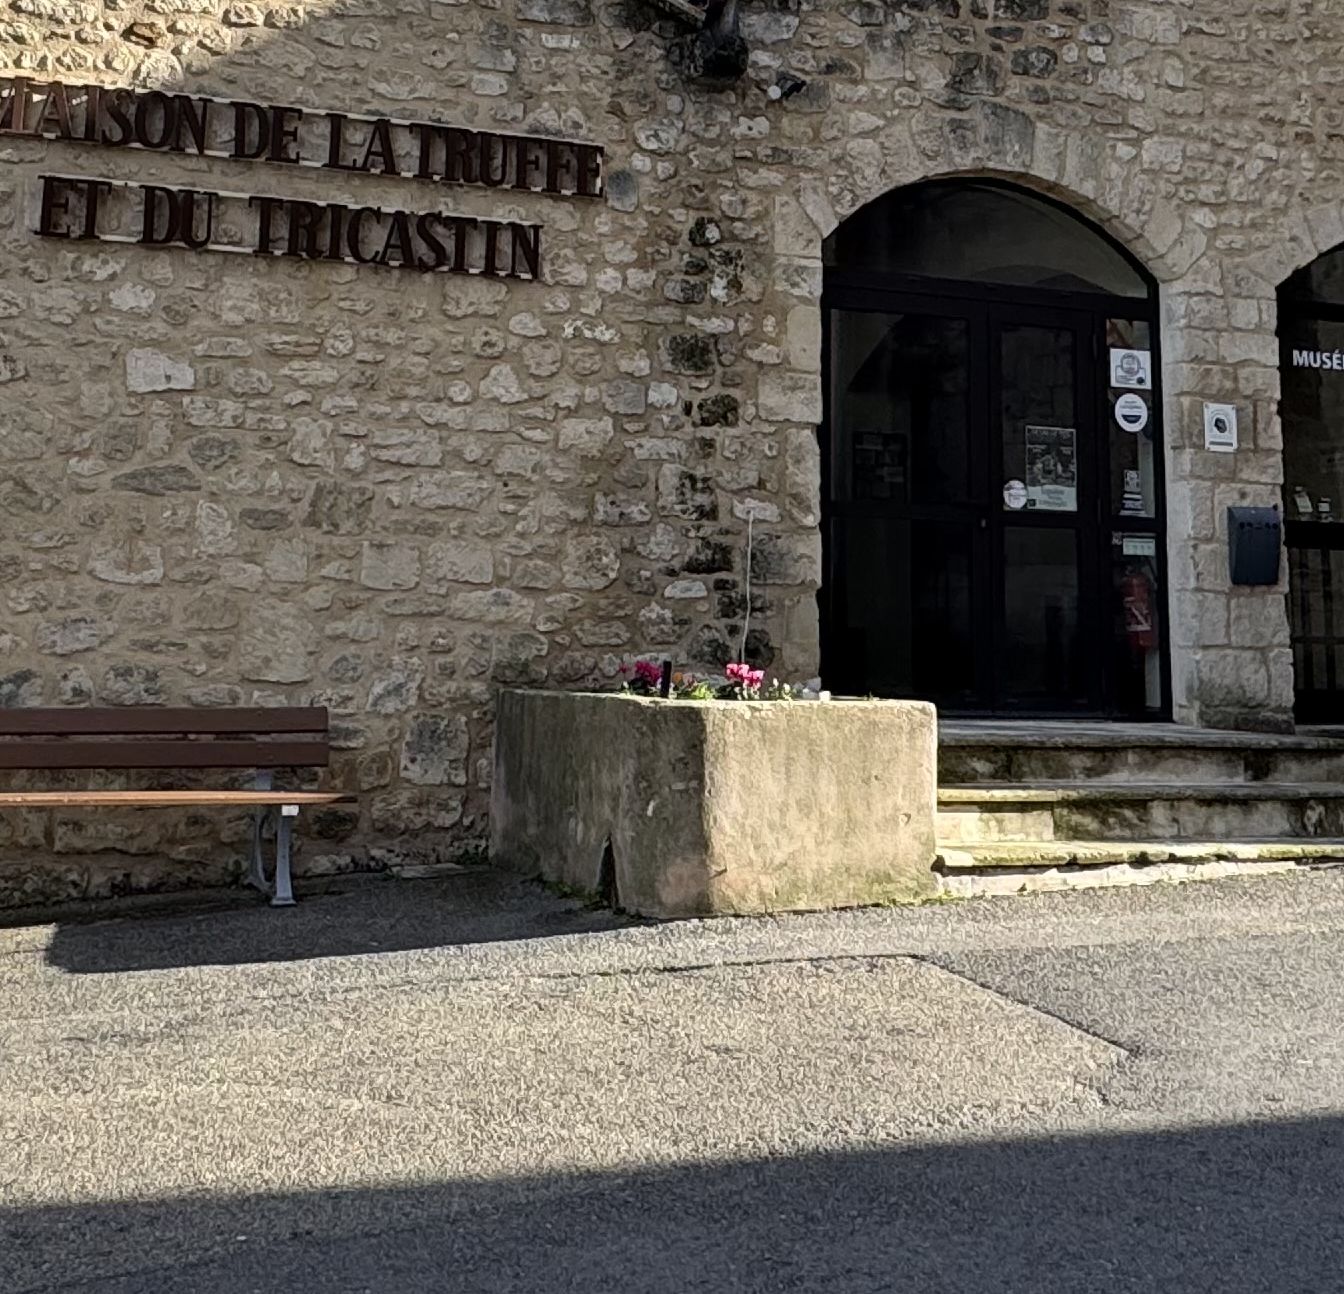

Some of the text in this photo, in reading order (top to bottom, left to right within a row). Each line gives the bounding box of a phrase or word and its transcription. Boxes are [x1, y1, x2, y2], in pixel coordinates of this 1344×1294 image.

[229, 101, 303, 165] DE
[321, 113, 396, 175] LA
[408, 122, 605, 198] TRUFFE
[34, 175, 544, 283] ET DU TRICASTIN
